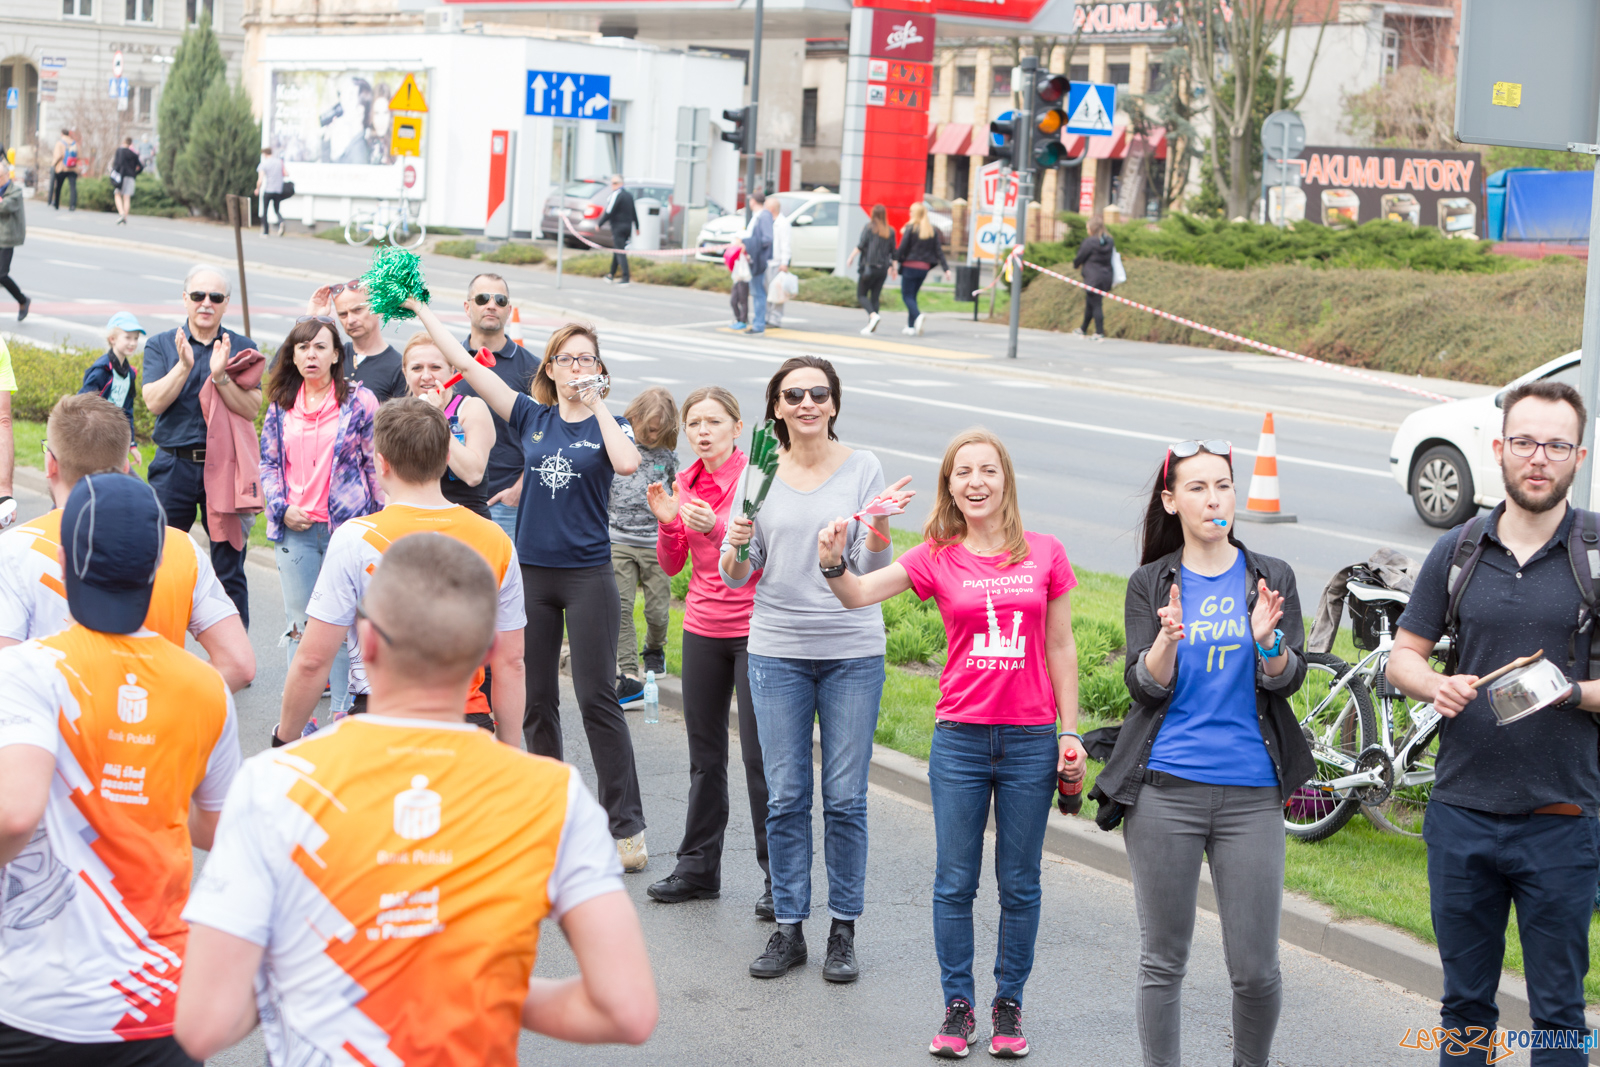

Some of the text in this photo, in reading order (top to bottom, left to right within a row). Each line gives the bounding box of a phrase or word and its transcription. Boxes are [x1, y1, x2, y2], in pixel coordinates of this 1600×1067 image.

[1305, 153, 1475, 192] AKUMULATORY
[962, 575, 1034, 589] PIĄTKOWO
[1003, 587, 1034, 595] biegowo
[1199, 595, 1235, 617] GO
[1189, 615, 1246, 646] RUN
[1206, 643, 1242, 673] IT
